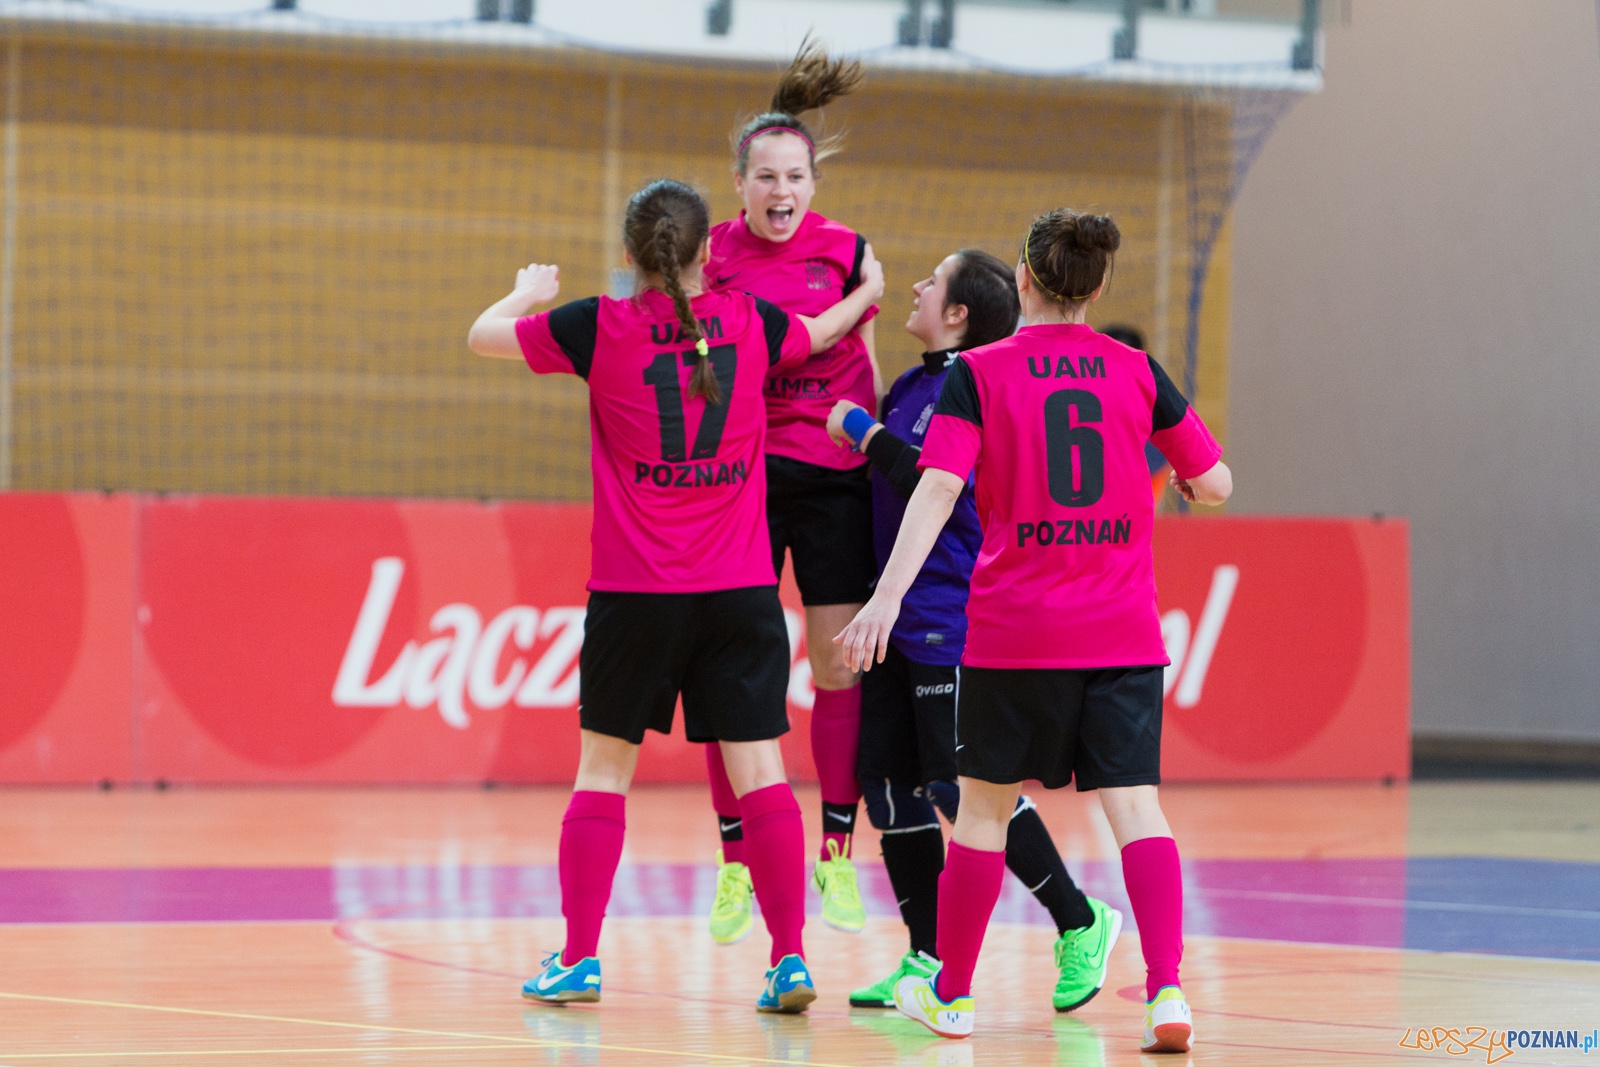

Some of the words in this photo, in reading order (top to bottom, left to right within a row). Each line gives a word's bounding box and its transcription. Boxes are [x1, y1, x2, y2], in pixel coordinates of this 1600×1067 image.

[1027, 356, 1107, 379] UAM
[643, 343, 737, 463] 17
[767, 377, 832, 396] IMEX
[1044, 388, 1104, 508] 6
[1016, 513, 1132, 548] POZNAŃ
